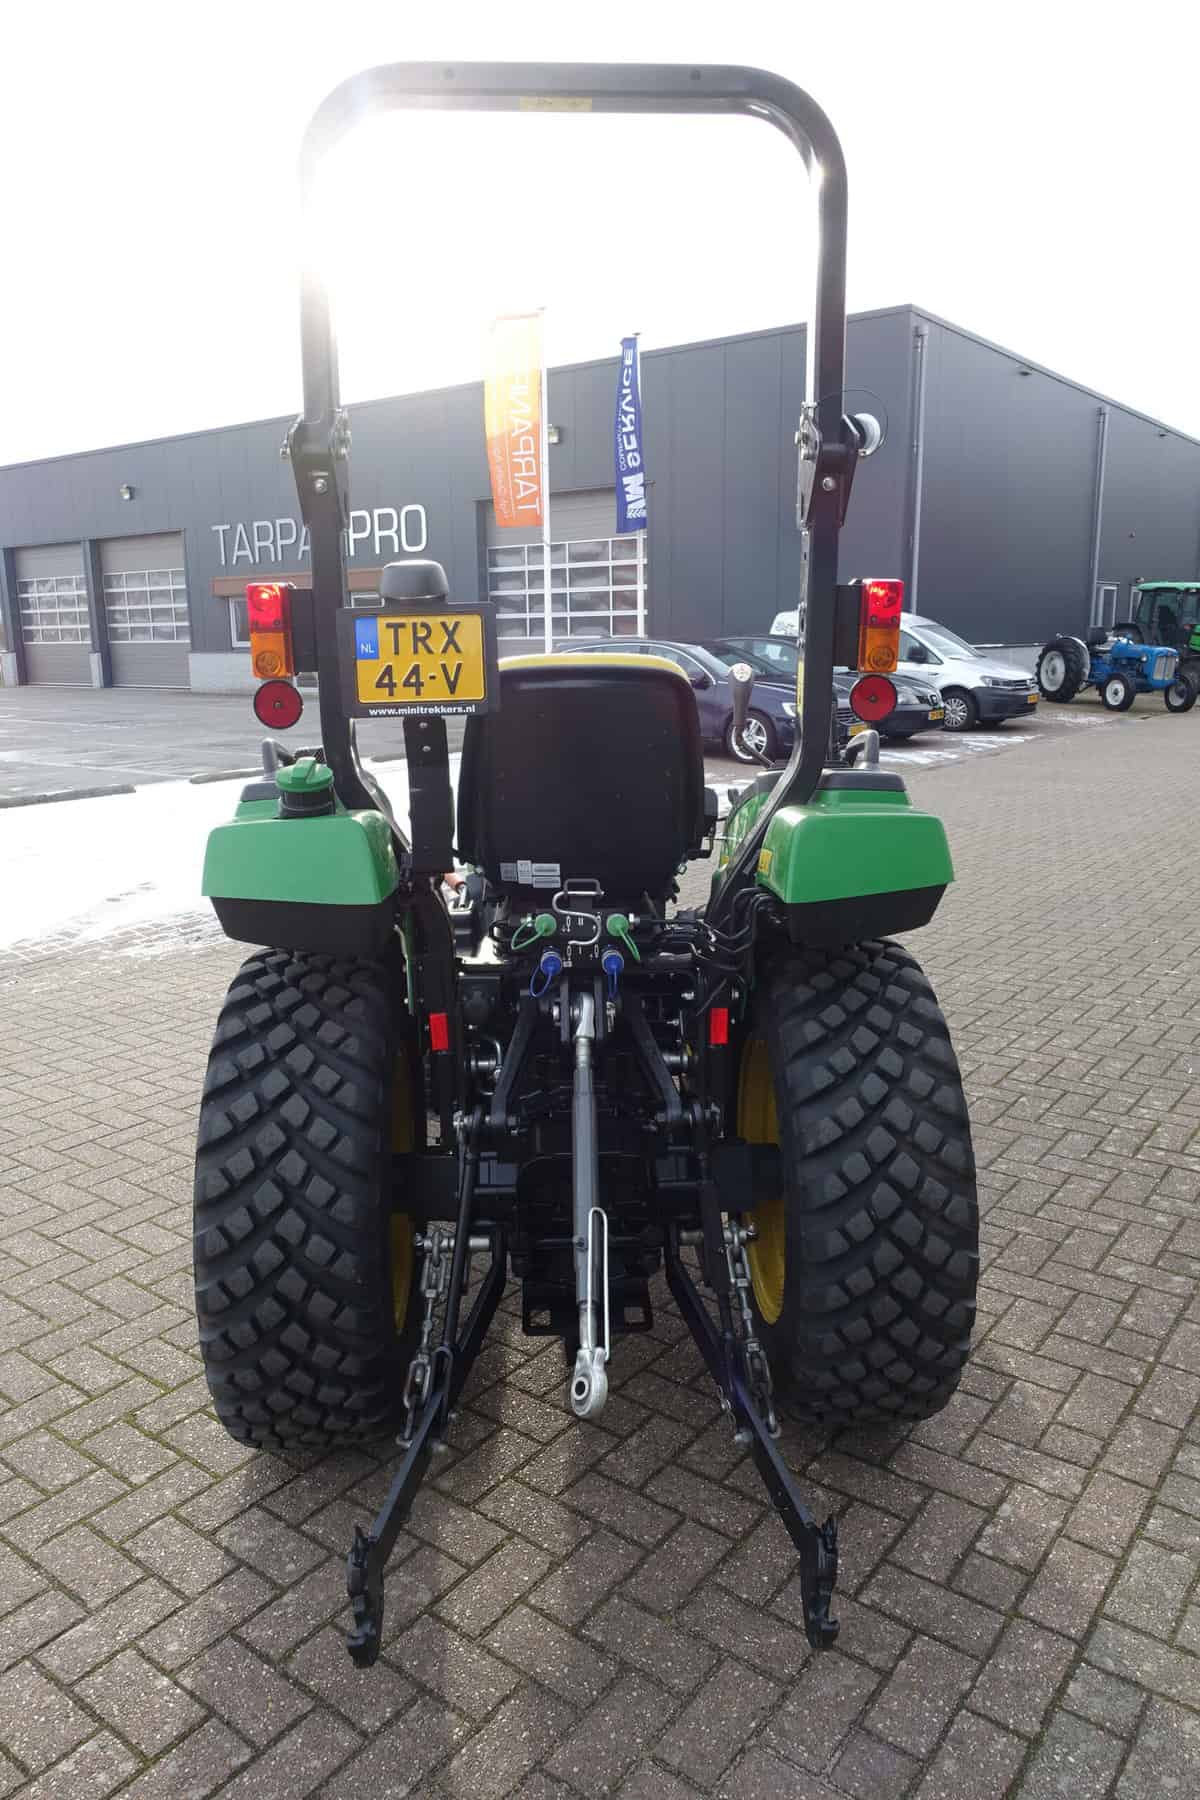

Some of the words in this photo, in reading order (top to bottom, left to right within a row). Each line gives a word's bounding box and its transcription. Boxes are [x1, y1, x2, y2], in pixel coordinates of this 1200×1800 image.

[211, 504, 428, 566] TARPAPRO
[360, 643, 375, 655] NL
[385, 620, 462, 656] TRX
[375, 662, 463, 697] 44-V
[368, 704, 476, 716] www.minitrekkers.nl
